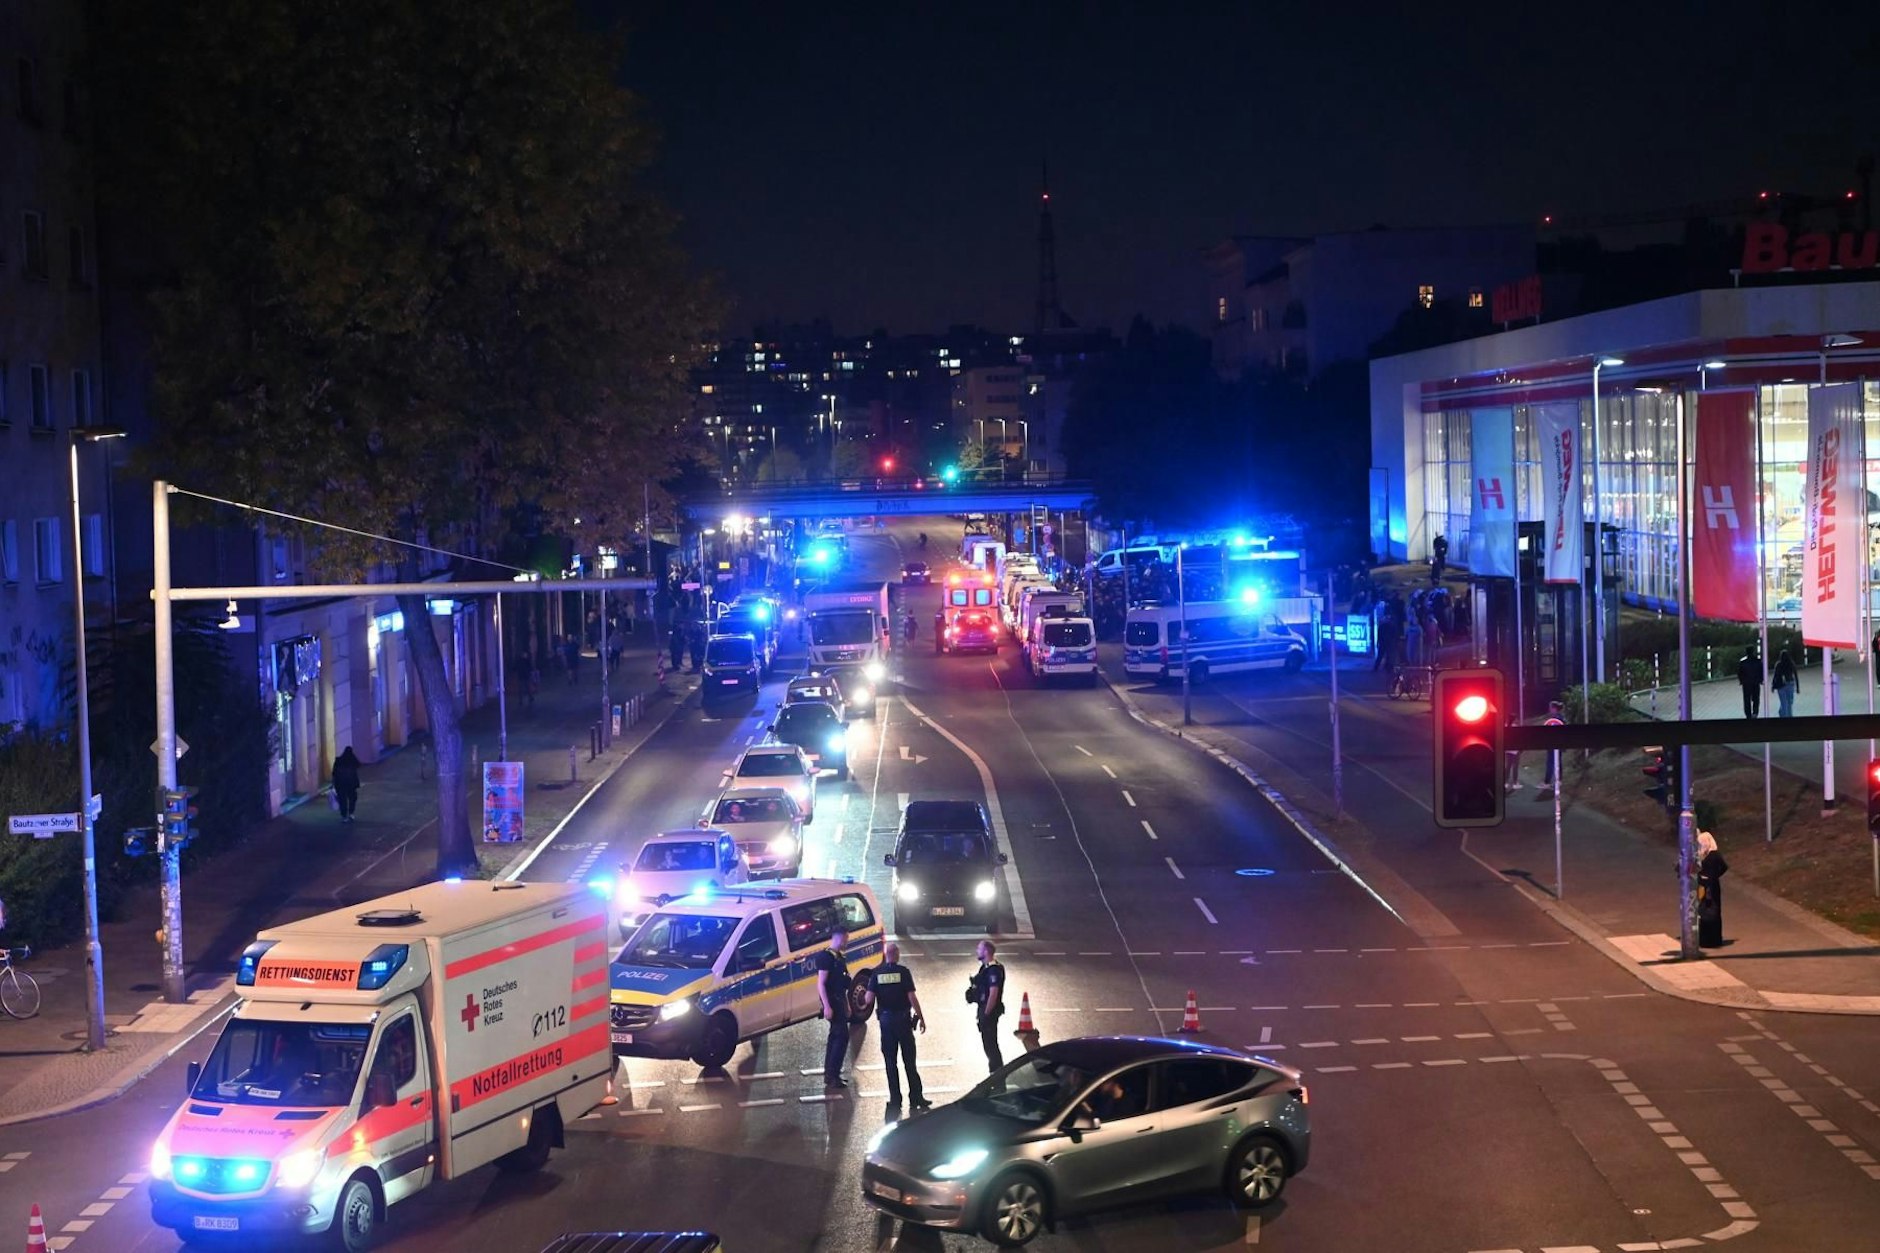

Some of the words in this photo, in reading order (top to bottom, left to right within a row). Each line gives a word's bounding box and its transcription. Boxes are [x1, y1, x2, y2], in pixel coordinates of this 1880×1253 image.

[1742, 222, 1878, 273] Bau
[1702, 485, 1740, 530] H
[50, 818, 73, 827] Straße
[259, 966, 355, 982] RETTUNGSDIENST
[617, 971, 669, 981] POLIZEI
[482, 980, 518, 1000] Deutsches
[483, 998, 503, 1013] Rotes
[484, 1011, 504, 1026] Kreuz
[544, 1005, 566, 1031] 112
[472, 1047, 563, 1097] Notfallrettung
[248, 1128, 275, 1136] Kreuz
